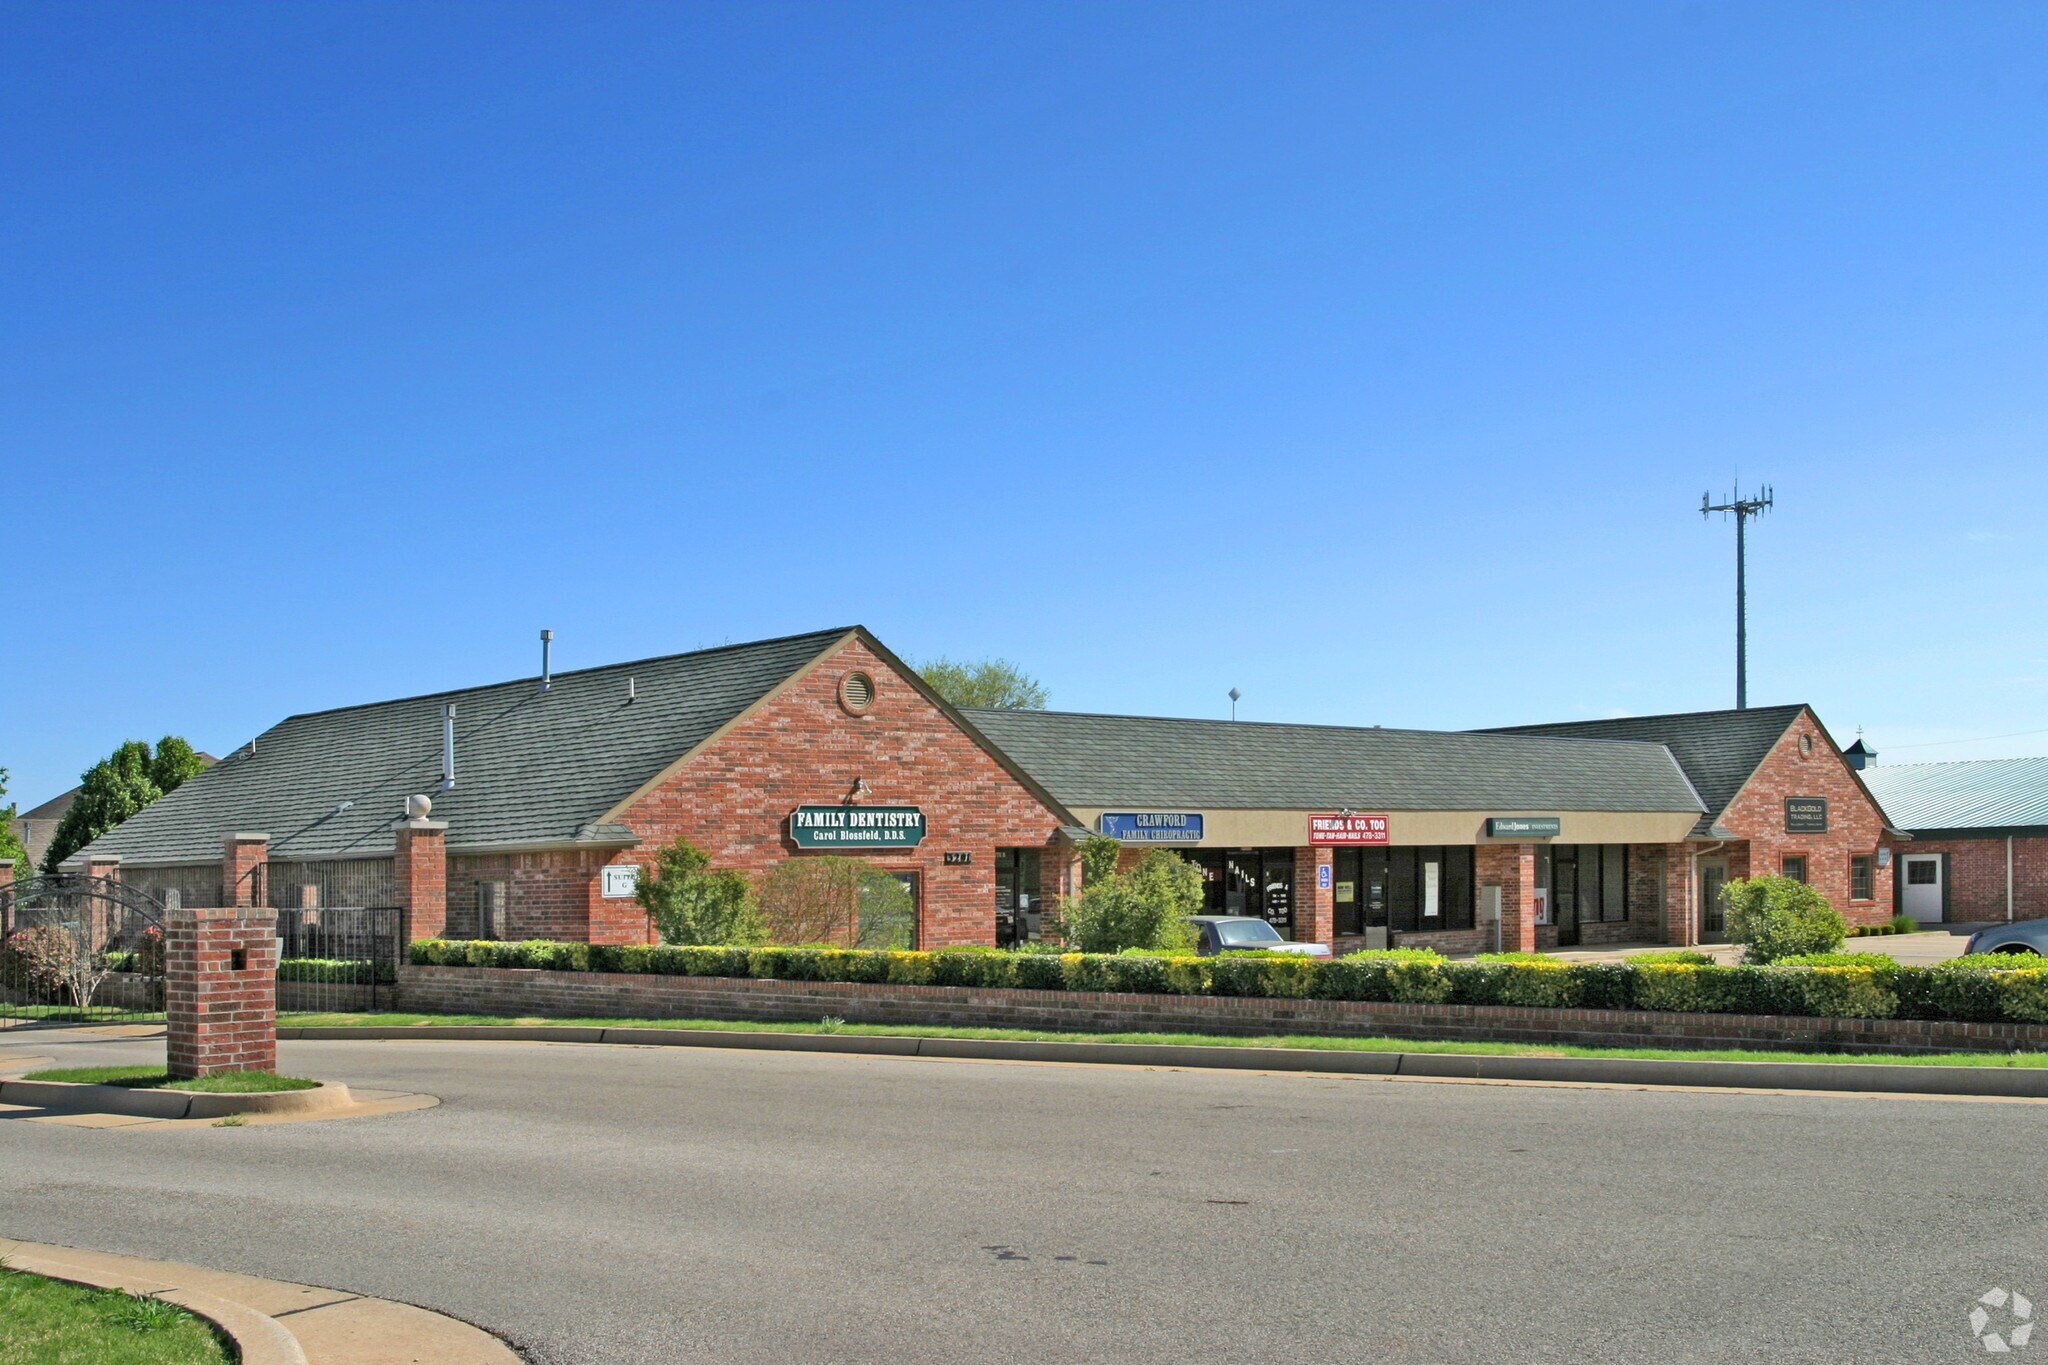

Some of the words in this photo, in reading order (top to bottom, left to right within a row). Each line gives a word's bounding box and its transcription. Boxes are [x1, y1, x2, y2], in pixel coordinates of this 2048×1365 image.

[797, 812, 845, 827] FAMILY
[849, 812, 920, 827] DENTISTRY
[1136, 814, 1187, 827] CRAWFORD
[1347, 819, 1352, 830] &
[1355, 819, 1368, 830] CO.
[1370, 819, 1385, 831] TOO
[813, 830, 836, 840] Carol
[840, 830, 881, 841] Blossfeld,
[884, 830, 906, 840] D.D.S.
[1122, 830, 1149, 840] FAMILY
[1151, 830, 1201, 840] CHIROPRACTIC
[1228, 861, 1256, 887] NAILS
